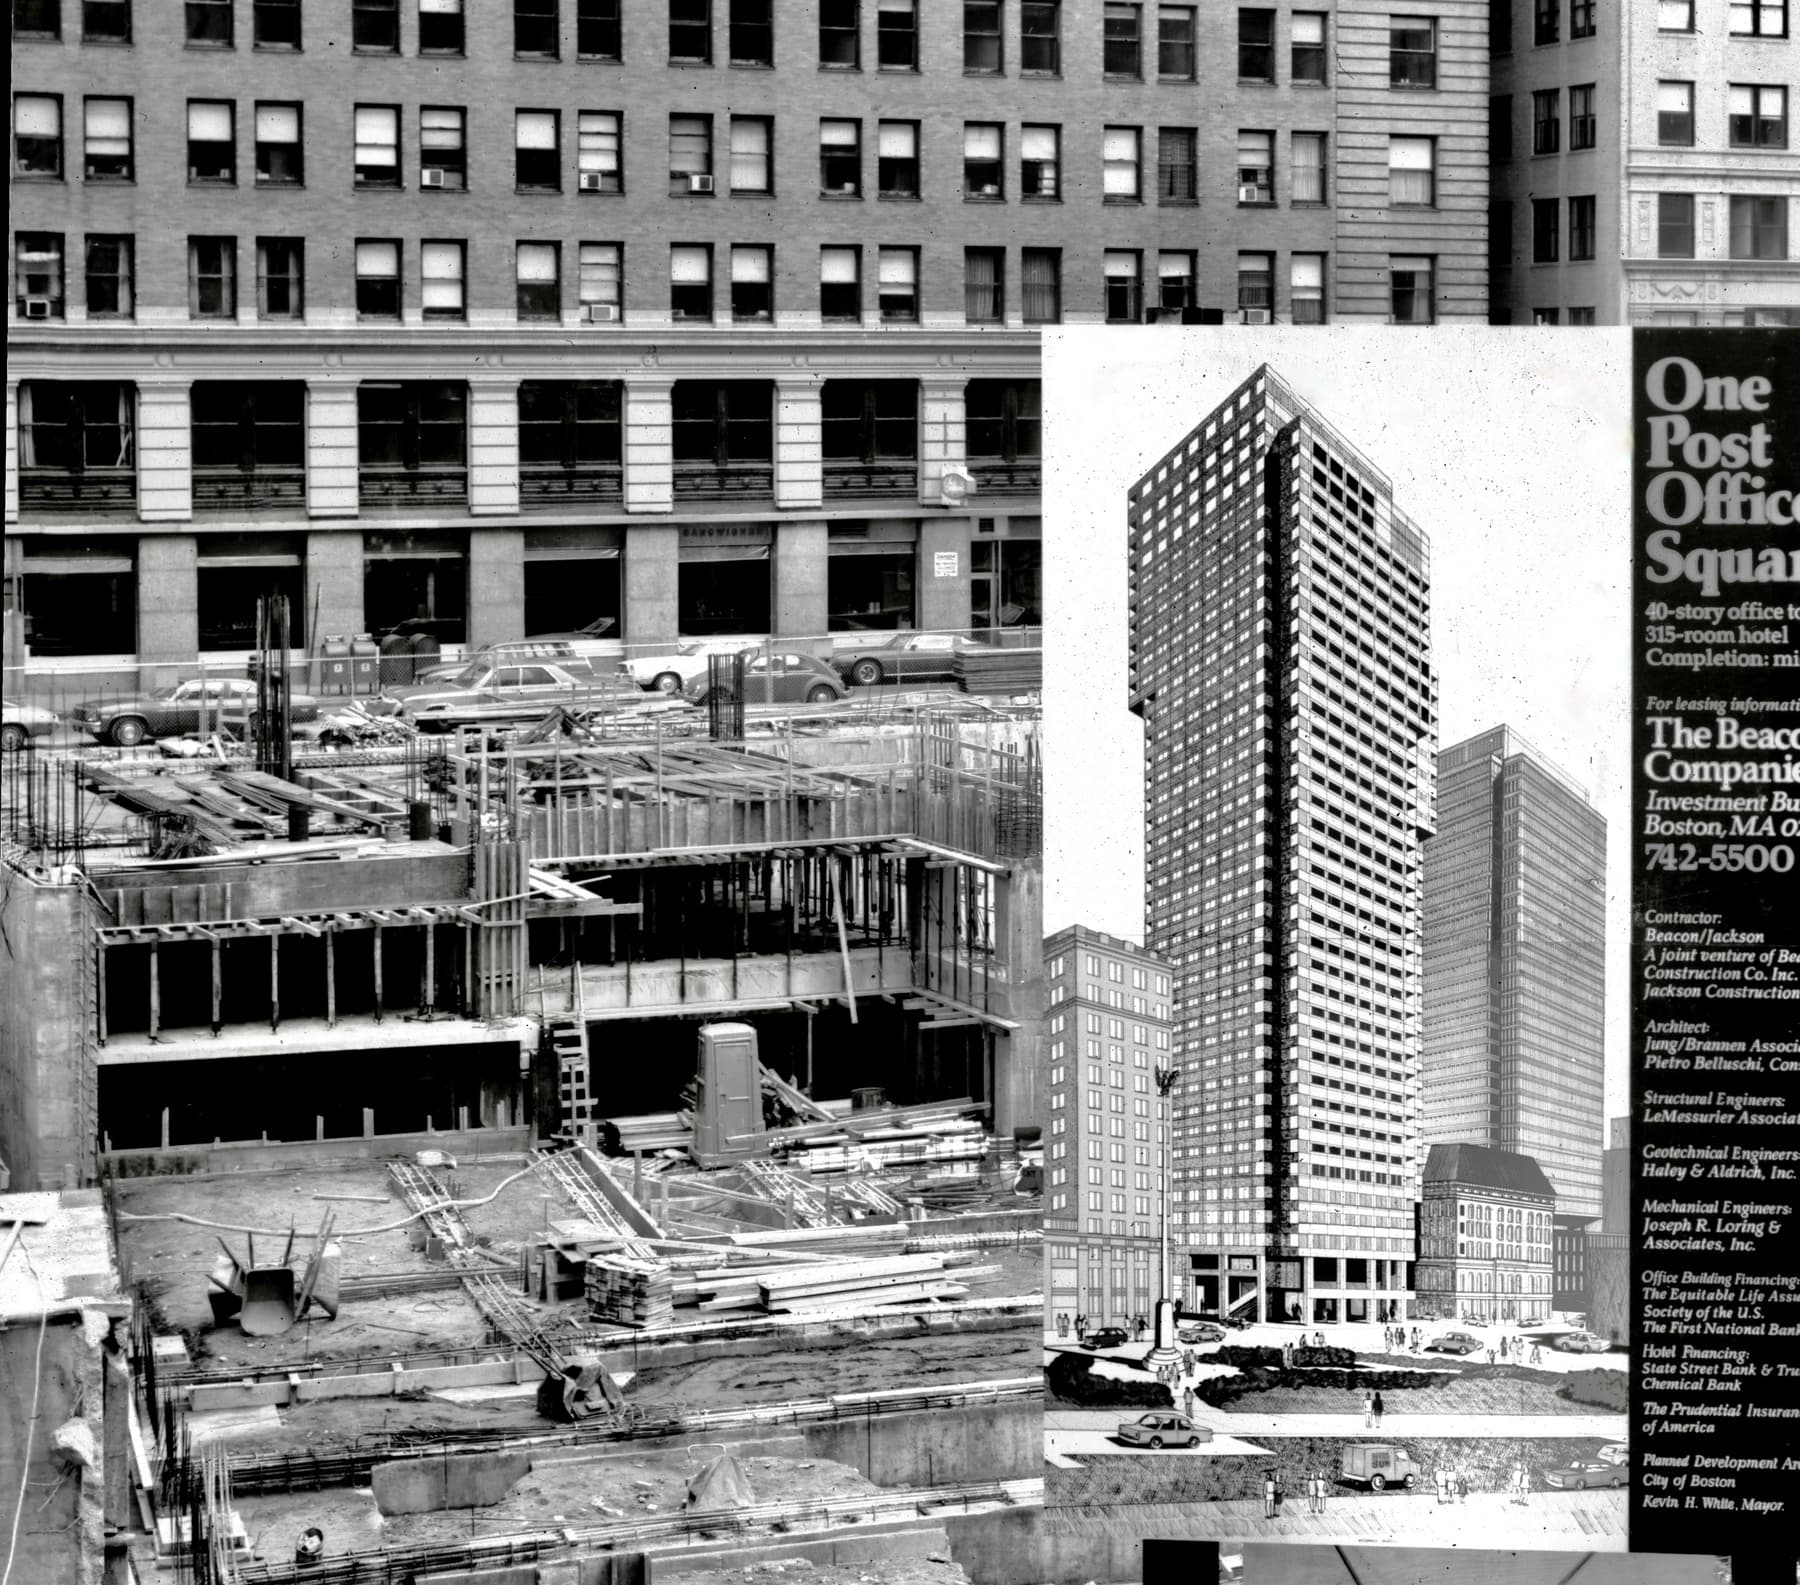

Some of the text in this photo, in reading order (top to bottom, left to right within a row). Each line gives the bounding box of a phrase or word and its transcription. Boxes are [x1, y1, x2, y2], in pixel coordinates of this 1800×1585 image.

[1646, 356, 1772, 411] One
[1646, 414, 1773, 469] Post
[1645, 602, 1724, 624] 40-story
[1728, 602, 1784, 620] office
[1645, 625, 1788, 644] 315-room hotel
[1646, 648, 1769, 671] Completion:
[1646, 696, 1671, 711] For
[1675, 697, 1726, 716] leasing
[1646, 717, 1712, 749] The
[1646, 790, 1768, 812] Investment
[1644, 815, 1727, 838] Boston,
[1729, 816, 1776, 836] MA
[1645, 843, 1795, 872] 742-5500
[1644, 909, 1722, 924] Contractor:
[1645, 928, 1765, 945] Beacon/Jackson
[1643, 948, 1656, 961] A
[1659, 948, 1697, 965] joint
[1701, 950, 1755, 963] venture
[1760, 950, 1776, 966] of
[1644, 965, 1741, 980] Construction
[1744, 967, 1768, 981] Co.
[1771, 967, 1798, 981] Inc.
[1643, 984, 1701, 1000] Jackson
[1705, 984, 1800, 999] Construction
[1644, 1020, 1710, 1033] Architect:
[1644, 1036, 1746, 1055] Jung/Brannen
[1644, 1055, 1690, 1069] Pietro
[1694, 1056, 1765, 1072] Belluschi,
[1644, 1090, 1785, 1111] Structural Engineers:
[1644, 1109, 1734, 1124] LeMessurier
[1642, 1144, 1728, 1159] Geotechnical
[1642, 1163, 1797, 1181] Haley & Aldrich, Inc.
[1642, 1199, 1792, 1218] Mechanical Engineers:
[1642, 1218, 1781, 1237] Joseph R. Loring &
[1643, 1236, 1756, 1252] Associates, Inc.
[1642, 1270, 1800, 1290] Office Building Financing:
[1642, 1288, 1667, 1300] The
[1670, 1288, 1735, 1304] Equitable
[1739, 1290, 1764, 1304] Life
[1644, 1305, 1764, 1321] Society of the U.S.
[1642, 1321, 1666, 1333] The
[1670, 1322, 1701, 1334] First
[1704, 1322, 1765, 1335] National
[1642, 1344, 1750, 1364] Hotel Financing:
[1642, 1362, 1676, 1375] State
[1680, 1363, 1718, 1375] Street
[1722, 1363, 1756, 1376] Bank
[1761, 1364, 1773, 1376] &
[1642, 1378, 1742, 1391] Chemical Bank
[1643, 1402, 1667, 1415] The
[1671, 1403, 1741, 1417] Prudential
[1642, 1421, 1715, 1435] of America
[1643, 1453, 1689, 1466] Planned
[1694, 1455, 1777, 1471] Development
[1643, 1473, 1736, 1490] City of Boston
[1643, 1495, 1784, 1514] Kevin H. White, Mayor.
